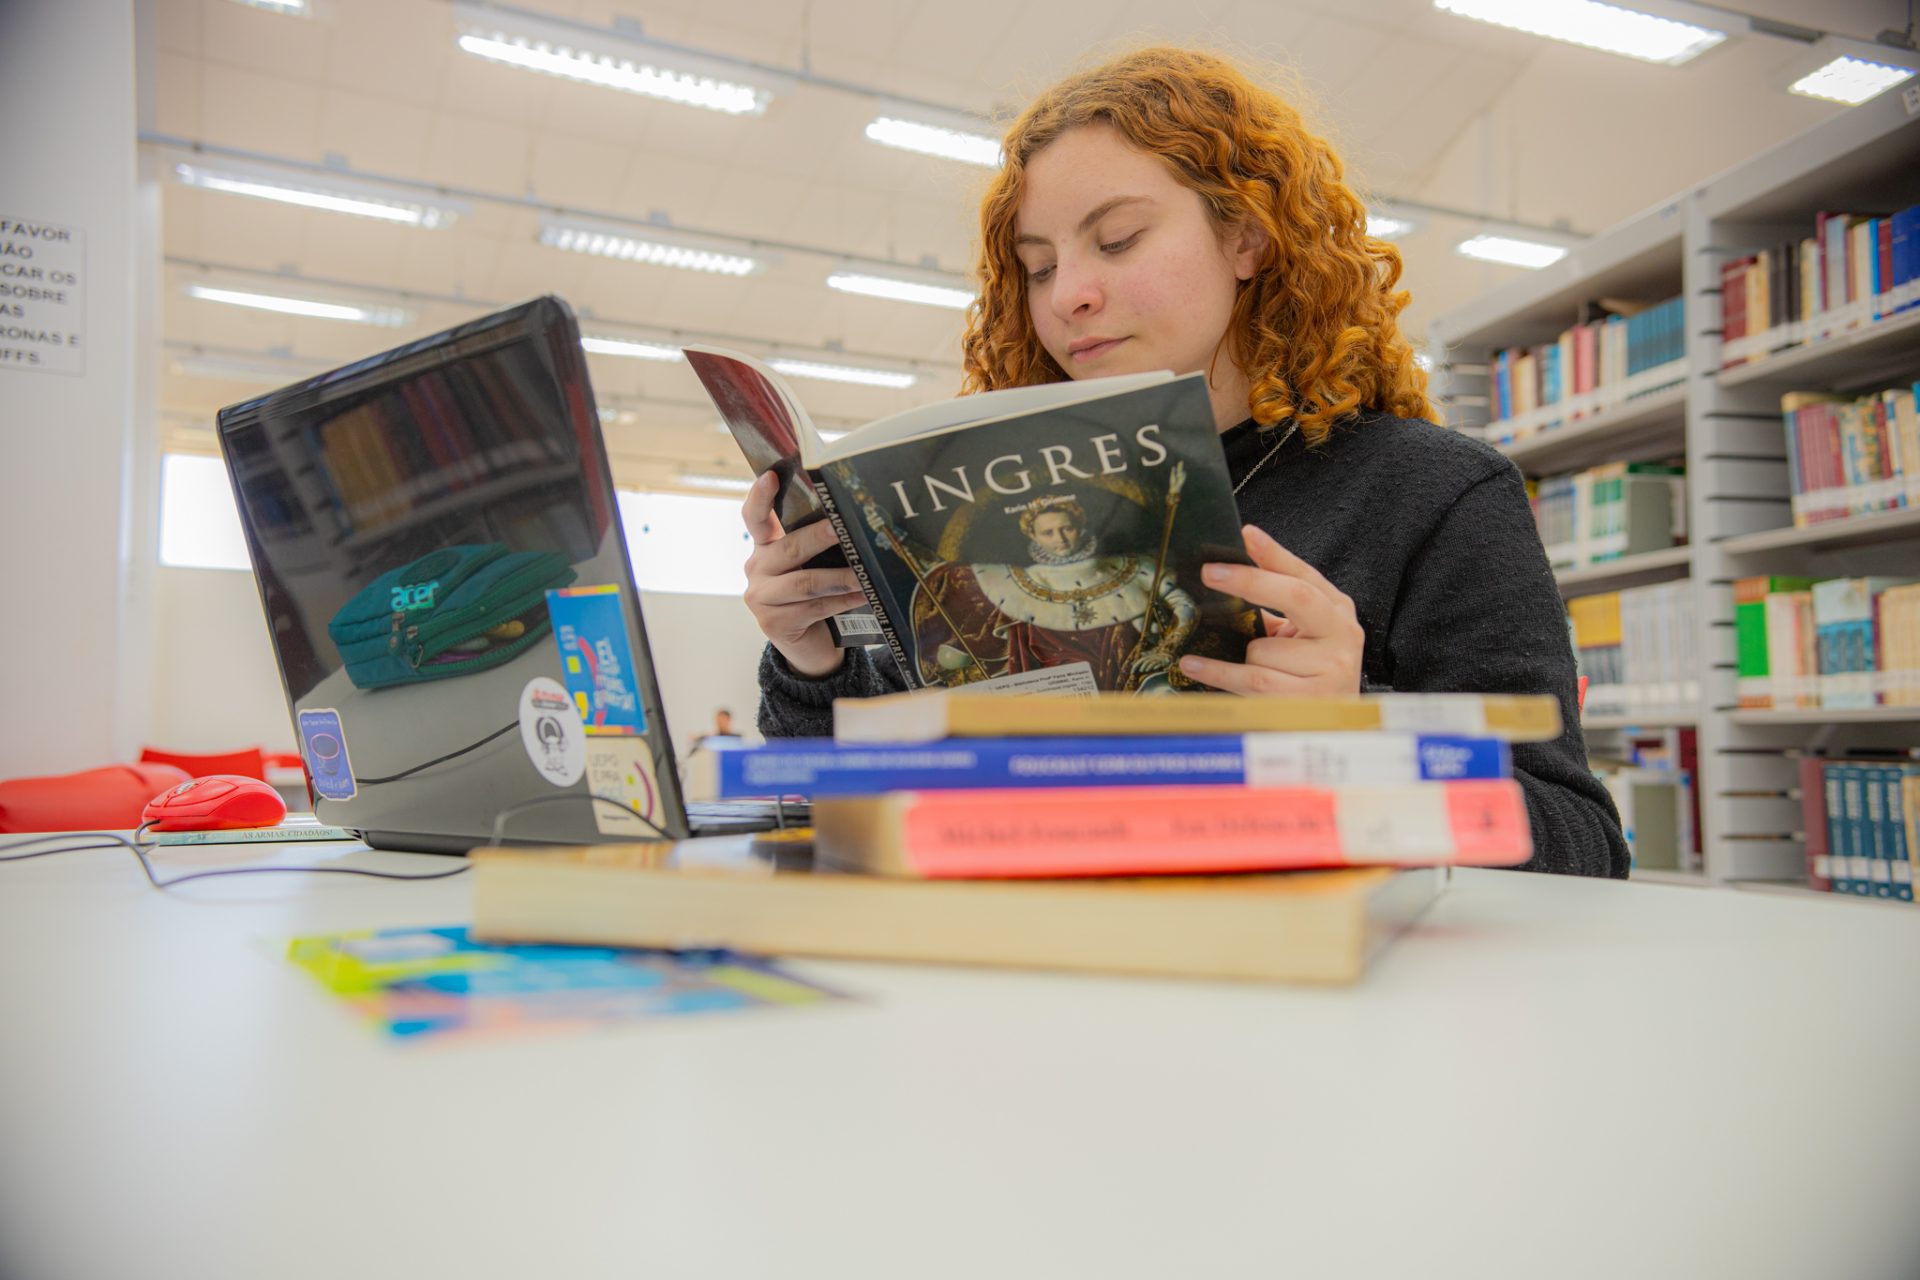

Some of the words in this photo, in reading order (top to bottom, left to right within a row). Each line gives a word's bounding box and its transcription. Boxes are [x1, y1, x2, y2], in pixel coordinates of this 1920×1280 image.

[1, 220, 70, 243] FAVOR
[0, 240, 33, 259] ÃO
[0, 263, 43, 278] CAR
[50, 270, 76, 286] OS
[0, 282, 67, 304] SOBRE
[892, 424, 1168, 519] INGRES
[814, 481, 890, 626] JEAN-AUGUSTE-DOMINIQUE
[883, 627, 907, 663] INGRES
[391, 581, 439, 611] acer
